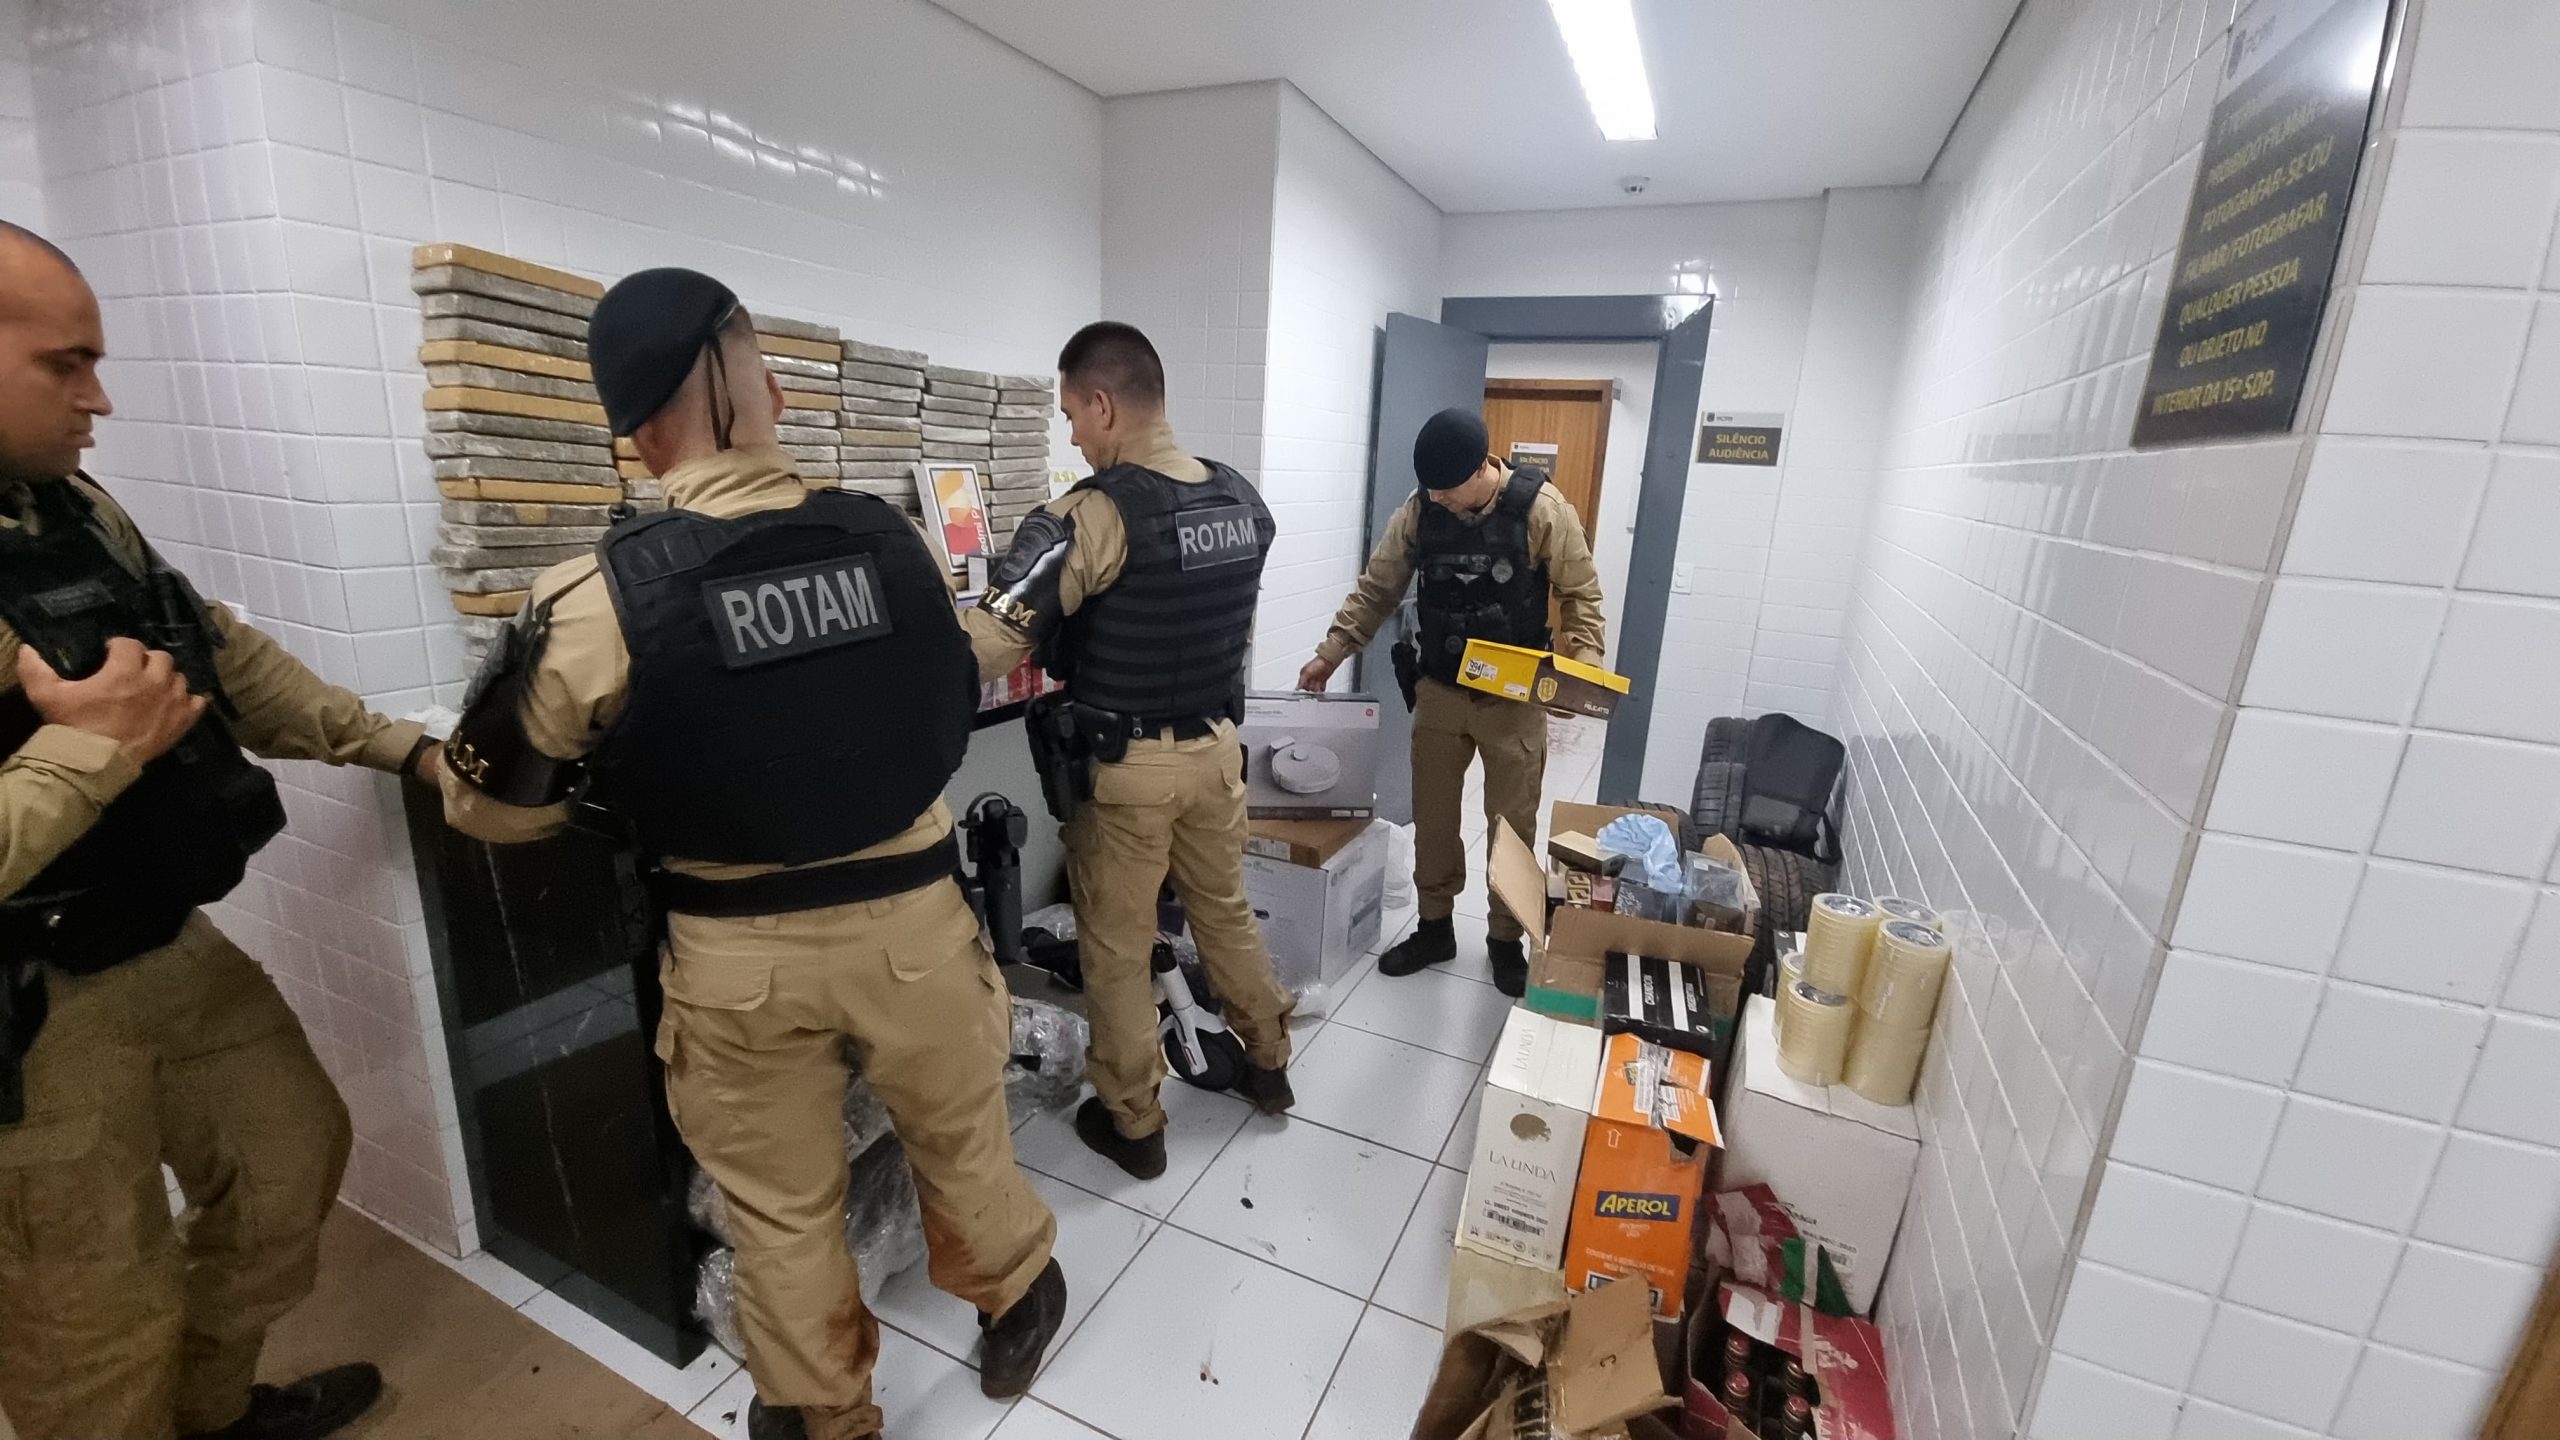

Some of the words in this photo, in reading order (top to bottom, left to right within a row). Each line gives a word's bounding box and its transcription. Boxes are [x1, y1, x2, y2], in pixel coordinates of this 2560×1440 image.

[2307, 135, 2334, 172] OU
[2179, 281, 2241, 331] QUALQUER
[2242, 258, 2300, 303] PESSOA
[2180, 343, 2198, 368] OU
[2197, 328, 2243, 362] OBJETO
[2243, 320, 2268, 349] NO
[2151, 386, 2202, 416] INTERIOR
[2201, 382, 2220, 407] DA
[1708, 446, 1769, 460] AUDIÊNCIA
[1716, 432, 1767, 445] SILÊNCIO
[1180, 517, 1256, 555] ROTAM
[721, 566, 879, 653] ROTAM
[983, 585, 1037, 628] TAM
[1489, 1150, 1508, 1168] LA
[1511, 1160, 1556, 1184] LINDA
[1600, 1194, 1671, 1216] APEROL
